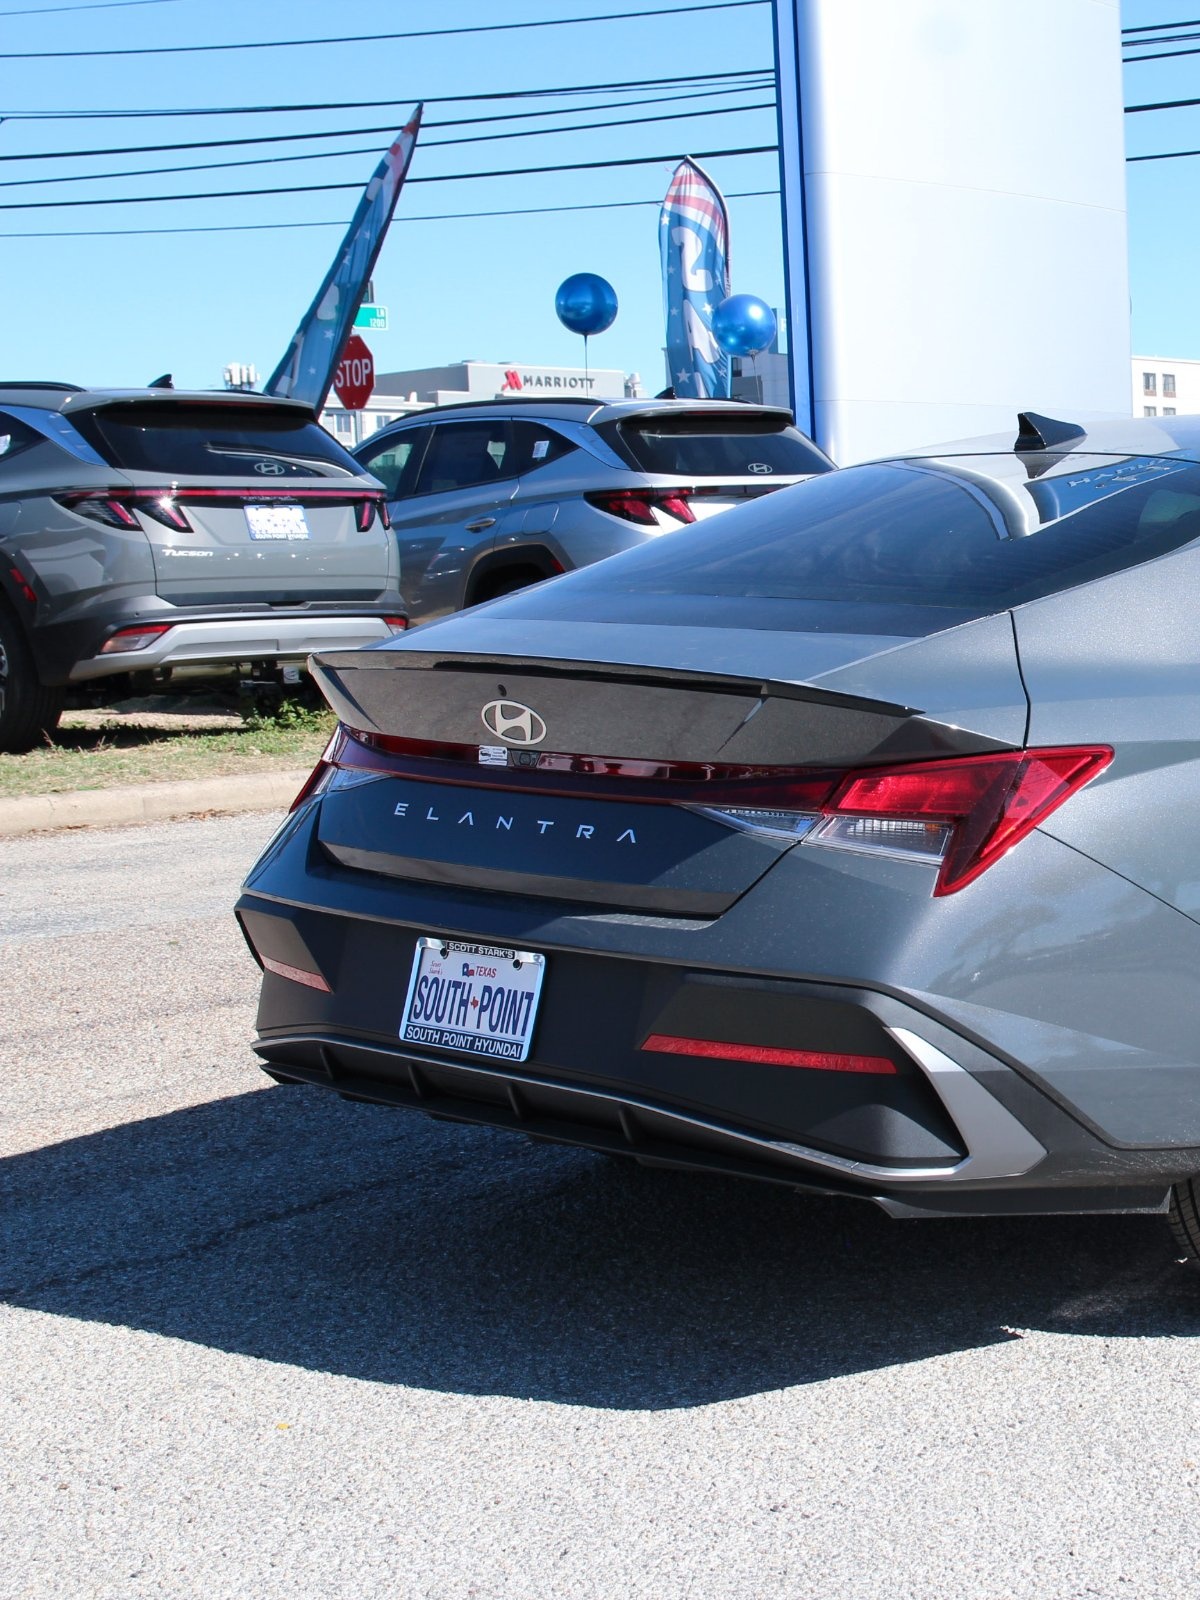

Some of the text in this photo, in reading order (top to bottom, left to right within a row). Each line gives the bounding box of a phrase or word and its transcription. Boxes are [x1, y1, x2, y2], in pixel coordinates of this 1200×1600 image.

[376, 308, 385, 317] LN
[370, 318, 385, 328] 1200
[335, 358, 371, 388] STOP
[523, 375, 595, 389] MARRIOTT
[393, 802, 637, 844] ELANTRA
[448, 942, 514, 959] SCOTT STARK'S
[475, 965, 497, 978] TEXAS
[413, 975, 535, 1037] SOUTH POINT
[406, 1025, 521, 1058] SOUTH POINT HYUNDAI
